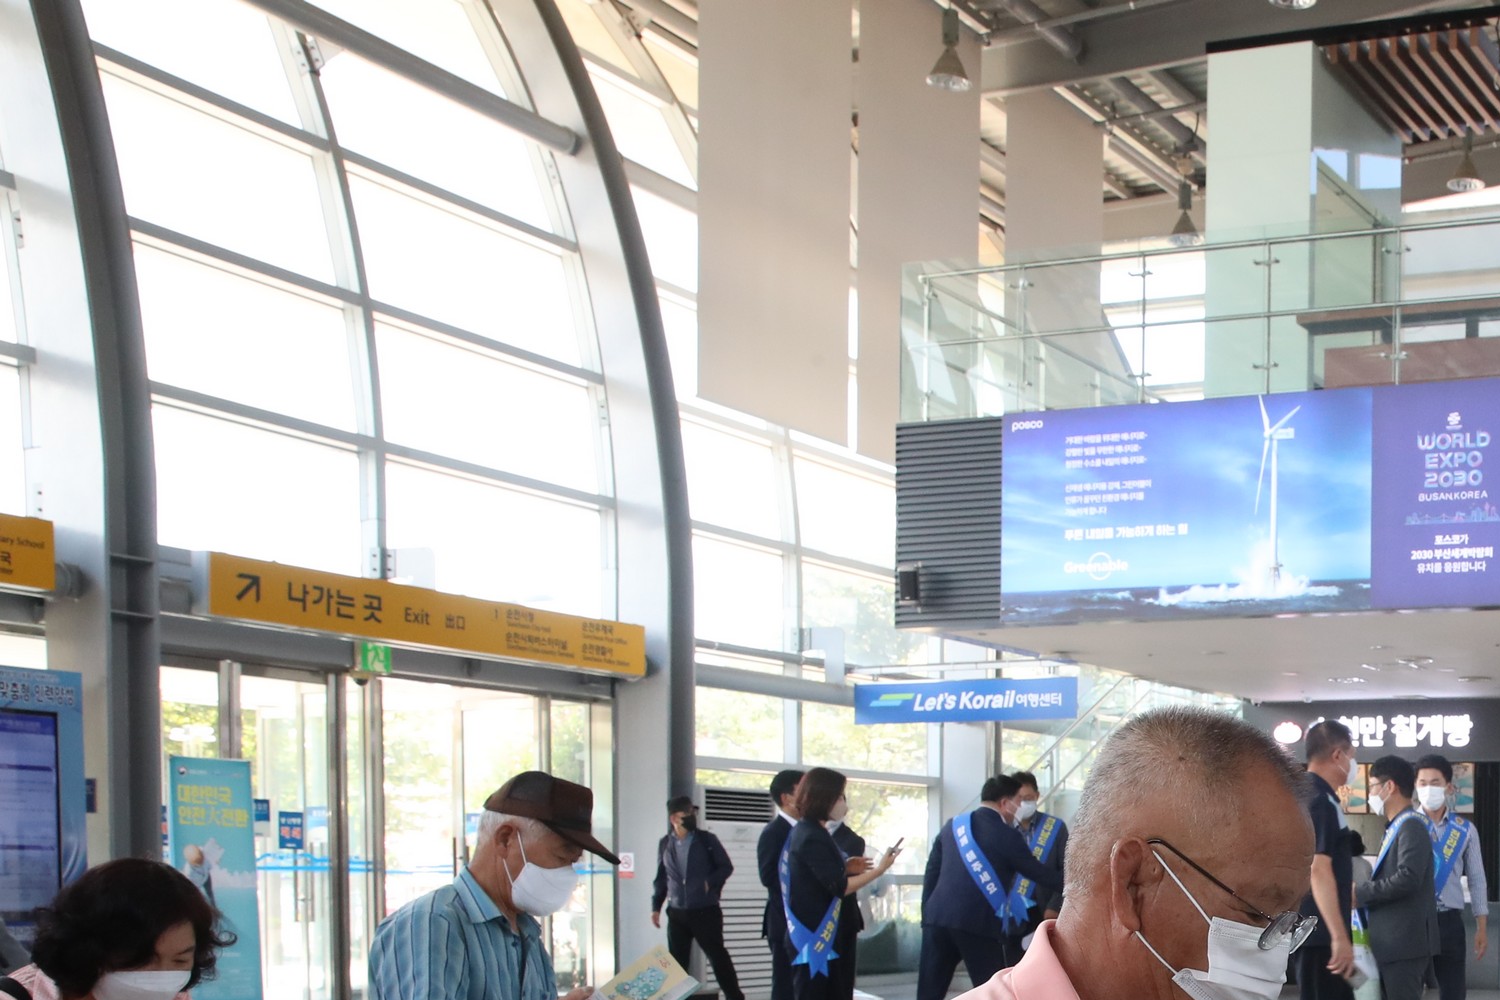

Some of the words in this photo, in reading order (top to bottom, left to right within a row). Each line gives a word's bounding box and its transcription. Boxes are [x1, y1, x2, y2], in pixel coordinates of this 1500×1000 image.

[1012, 420, 1043, 432] posco
[1417, 430, 1490, 450] WORLD
[1424, 451, 1483, 469] EXPO
[1424, 469, 1483, 488] 2030
[1116, 525, 1154, 538] 가능하게
[1156, 524, 1176, 536] 하는
[1434, 534, 1469, 545] 포스코가
[1411, 550, 1433, 560] 2030
[1064, 559, 1128, 574] Greenable
[1417, 562, 1442, 574] 유치를
[1444, 560, 1486, 573] 응원합니다
[288, 582, 355, 620] 나가는
[363, 594, 382, 623] 곳
[404, 607, 430, 626] Exit
[445, 614, 466, 630] 出口
[913, 692, 956, 712] Let's
[959, 690, 1015, 710] Korail
[1016, 692, 1062, 708] 여행센터
[177, 784, 232, 805] 대한민국
